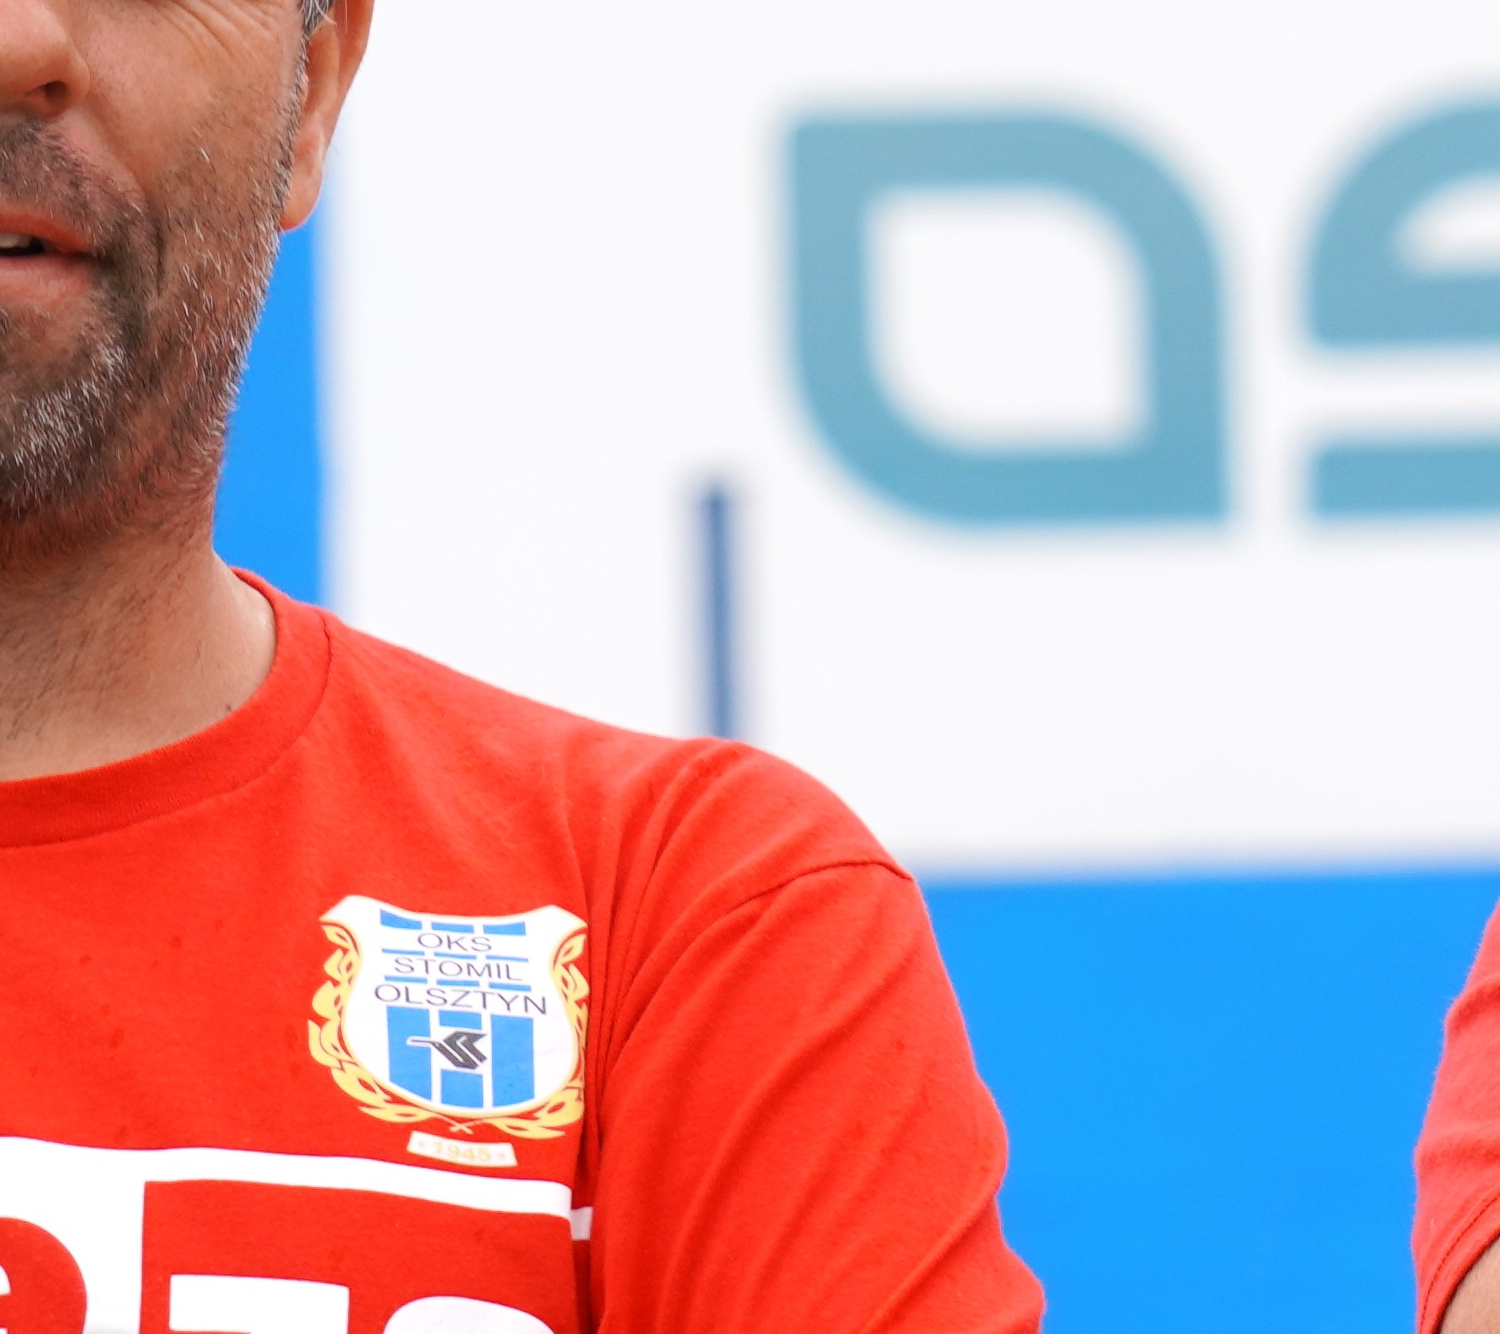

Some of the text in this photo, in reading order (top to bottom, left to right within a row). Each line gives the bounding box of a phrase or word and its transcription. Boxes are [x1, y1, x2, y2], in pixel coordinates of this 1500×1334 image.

[417, 932, 493, 953] OKS
[394, 956, 523, 982] STOMIL
[374, 984, 547, 1015] OLSZTYN
[434, 1139, 493, 1163] 1945
